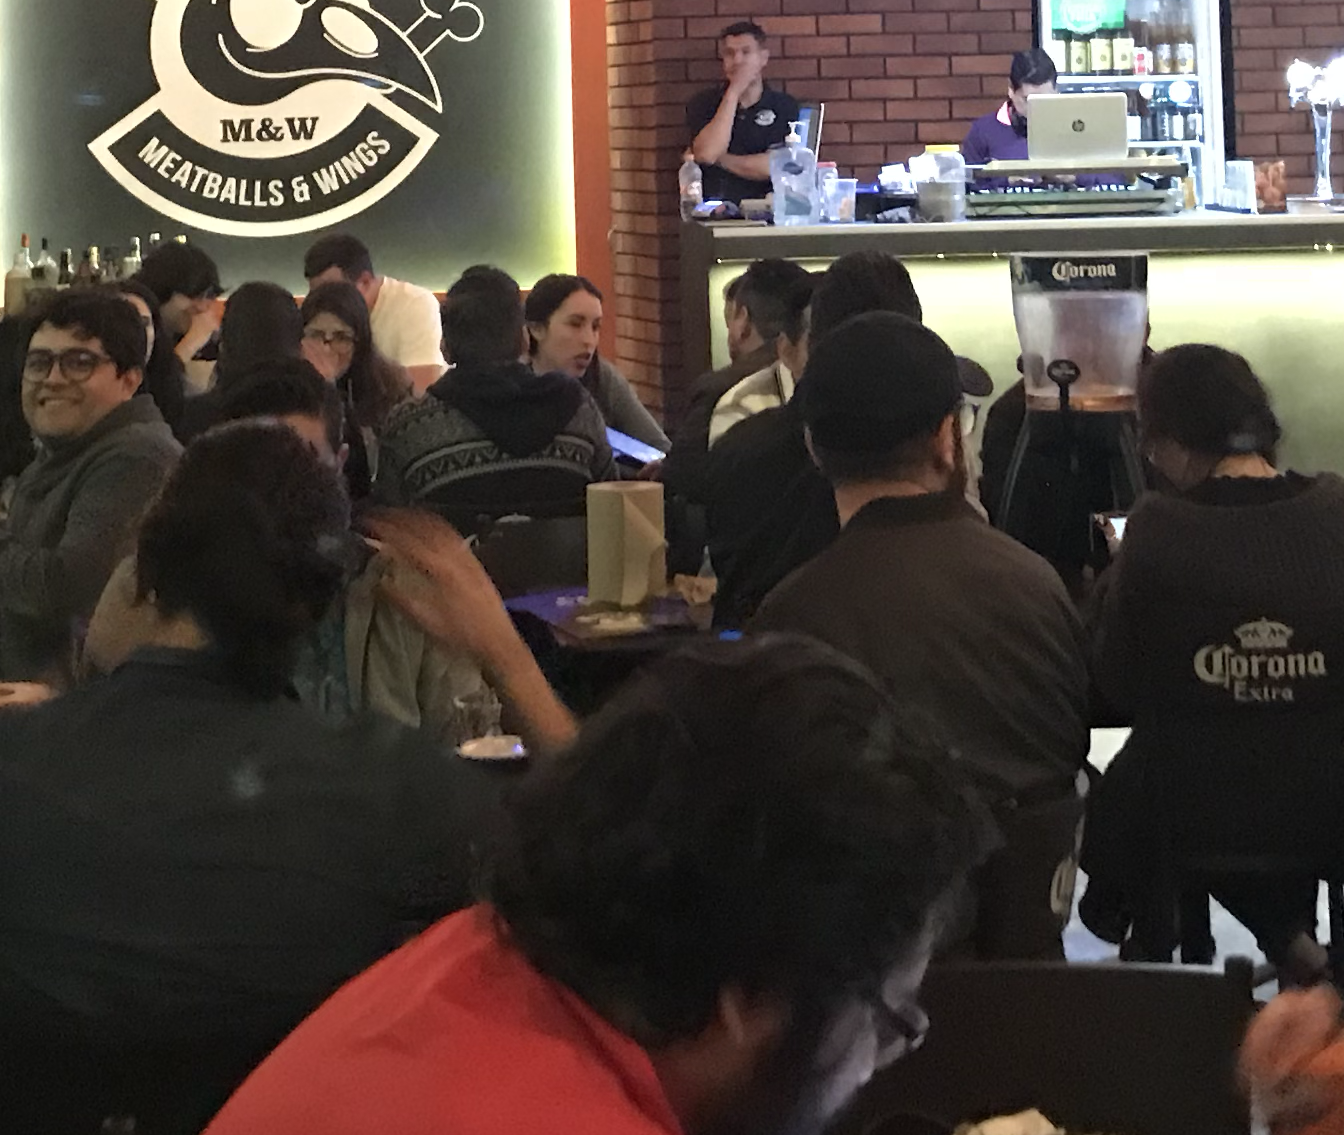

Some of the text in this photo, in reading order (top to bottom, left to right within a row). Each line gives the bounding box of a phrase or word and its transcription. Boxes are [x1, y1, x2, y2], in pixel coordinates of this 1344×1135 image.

[219, 116, 320, 143] M&W
[137, 130, 392, 208] MEATBALLS & WINGS
[1051, 260, 1117, 284] Corona
[1193, 643, 1328, 690] Corona
[1233, 680, 1295, 703] Extra
